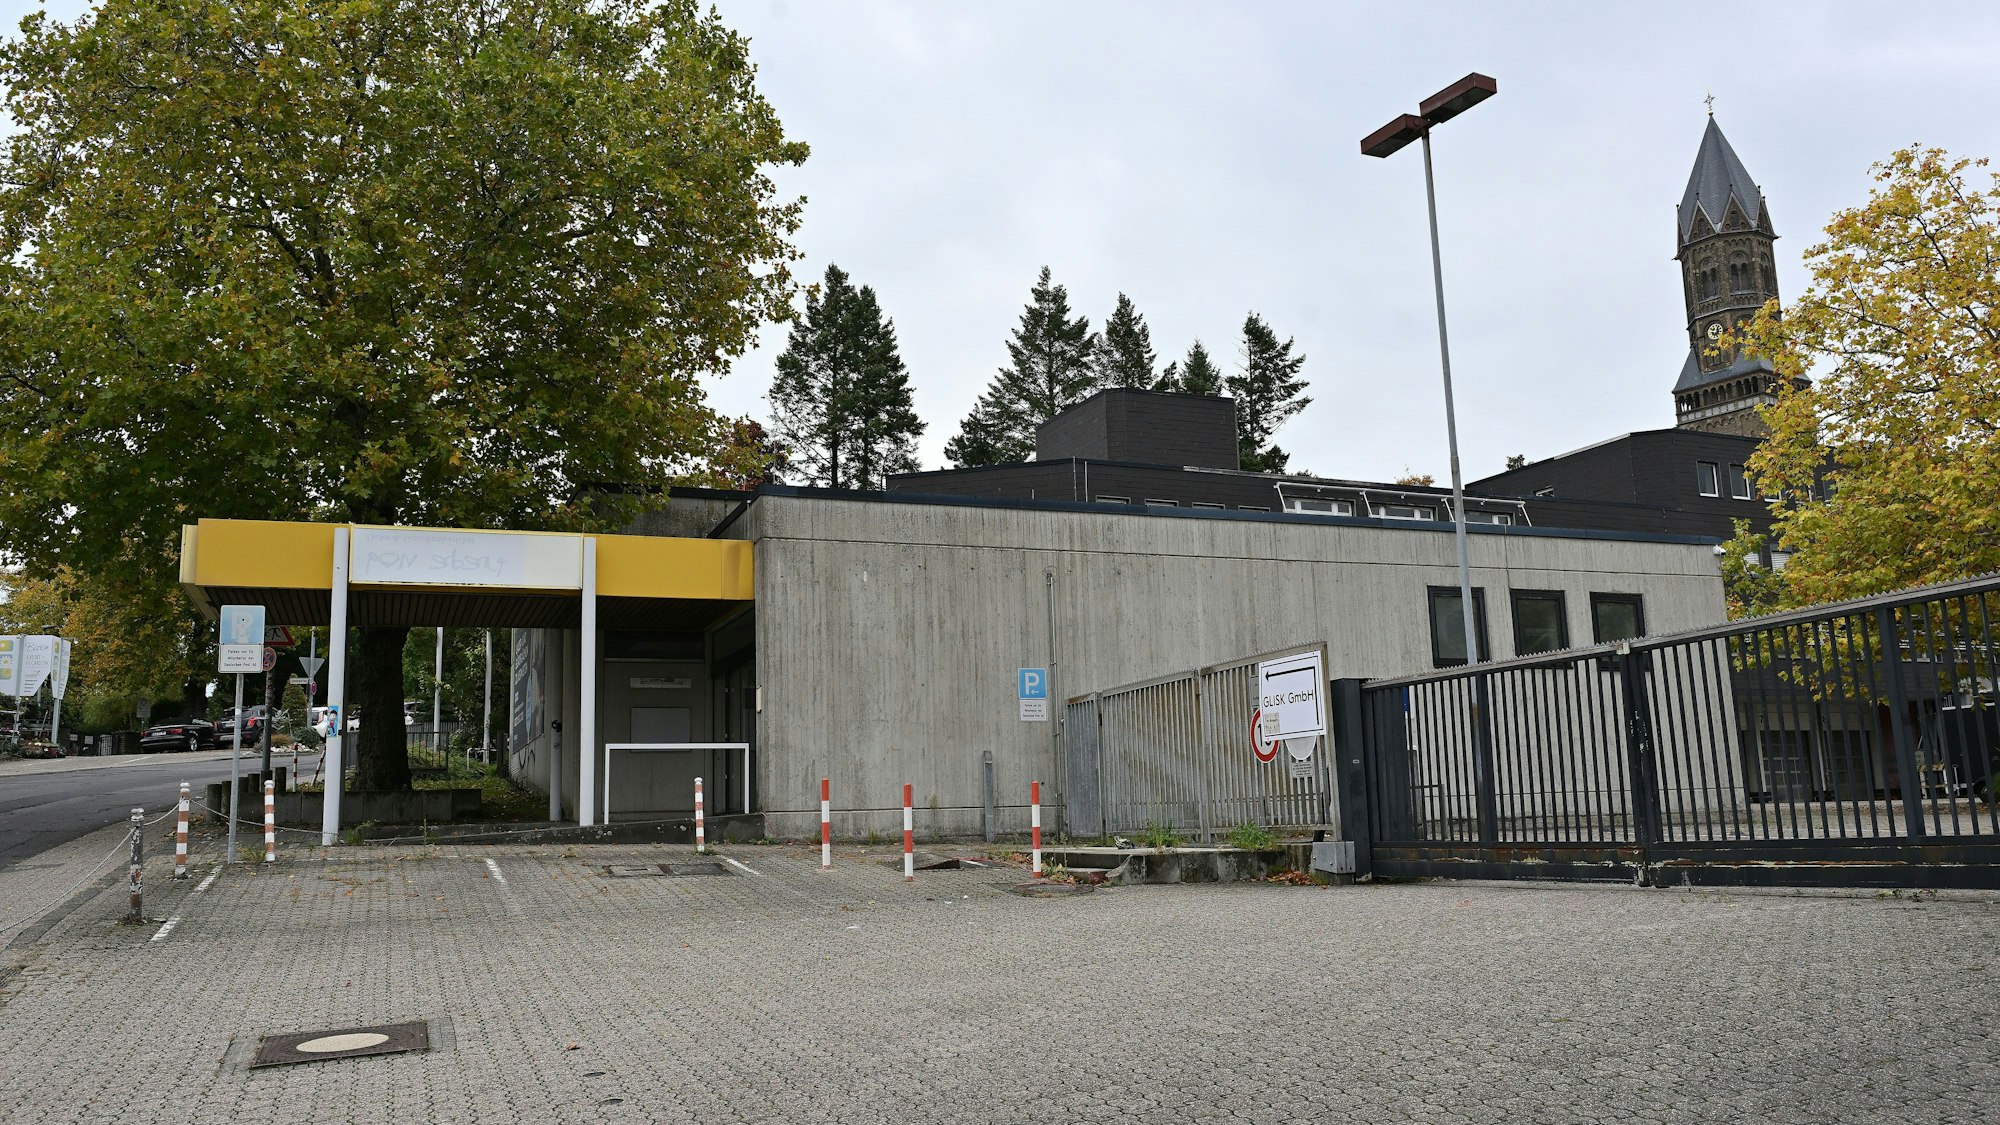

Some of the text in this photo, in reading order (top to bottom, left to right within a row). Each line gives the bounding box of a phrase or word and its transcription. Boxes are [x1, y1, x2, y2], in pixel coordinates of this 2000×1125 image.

[1025, 672, 1039, 694] P
[1264, 689, 1314, 708] GLISK GmbH
